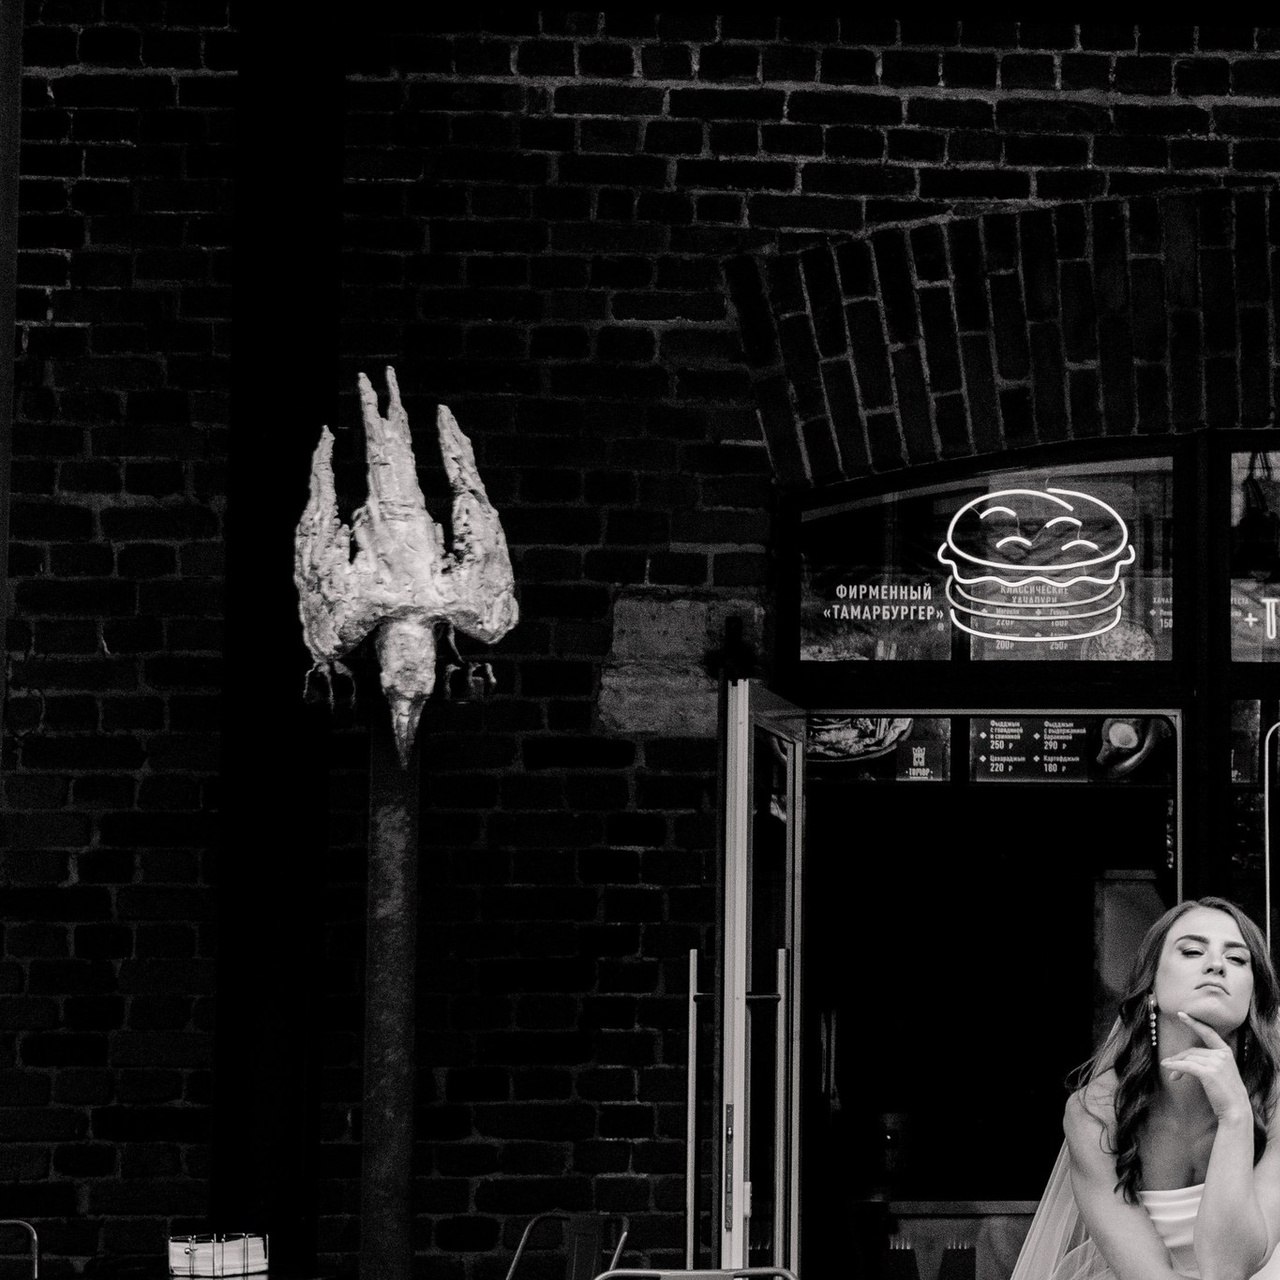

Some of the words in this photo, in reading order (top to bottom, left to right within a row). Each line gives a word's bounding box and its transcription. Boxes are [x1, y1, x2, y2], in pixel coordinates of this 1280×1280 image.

[835, 582, 933, 601] ФИРМЕННЫЙ
[823, 604, 944, 621] «ТАМАРБУРГЕР»
[990, 740, 1005, 750] 250
[1043, 740, 1059, 750] 290
[990, 763, 1004, 773] 220
